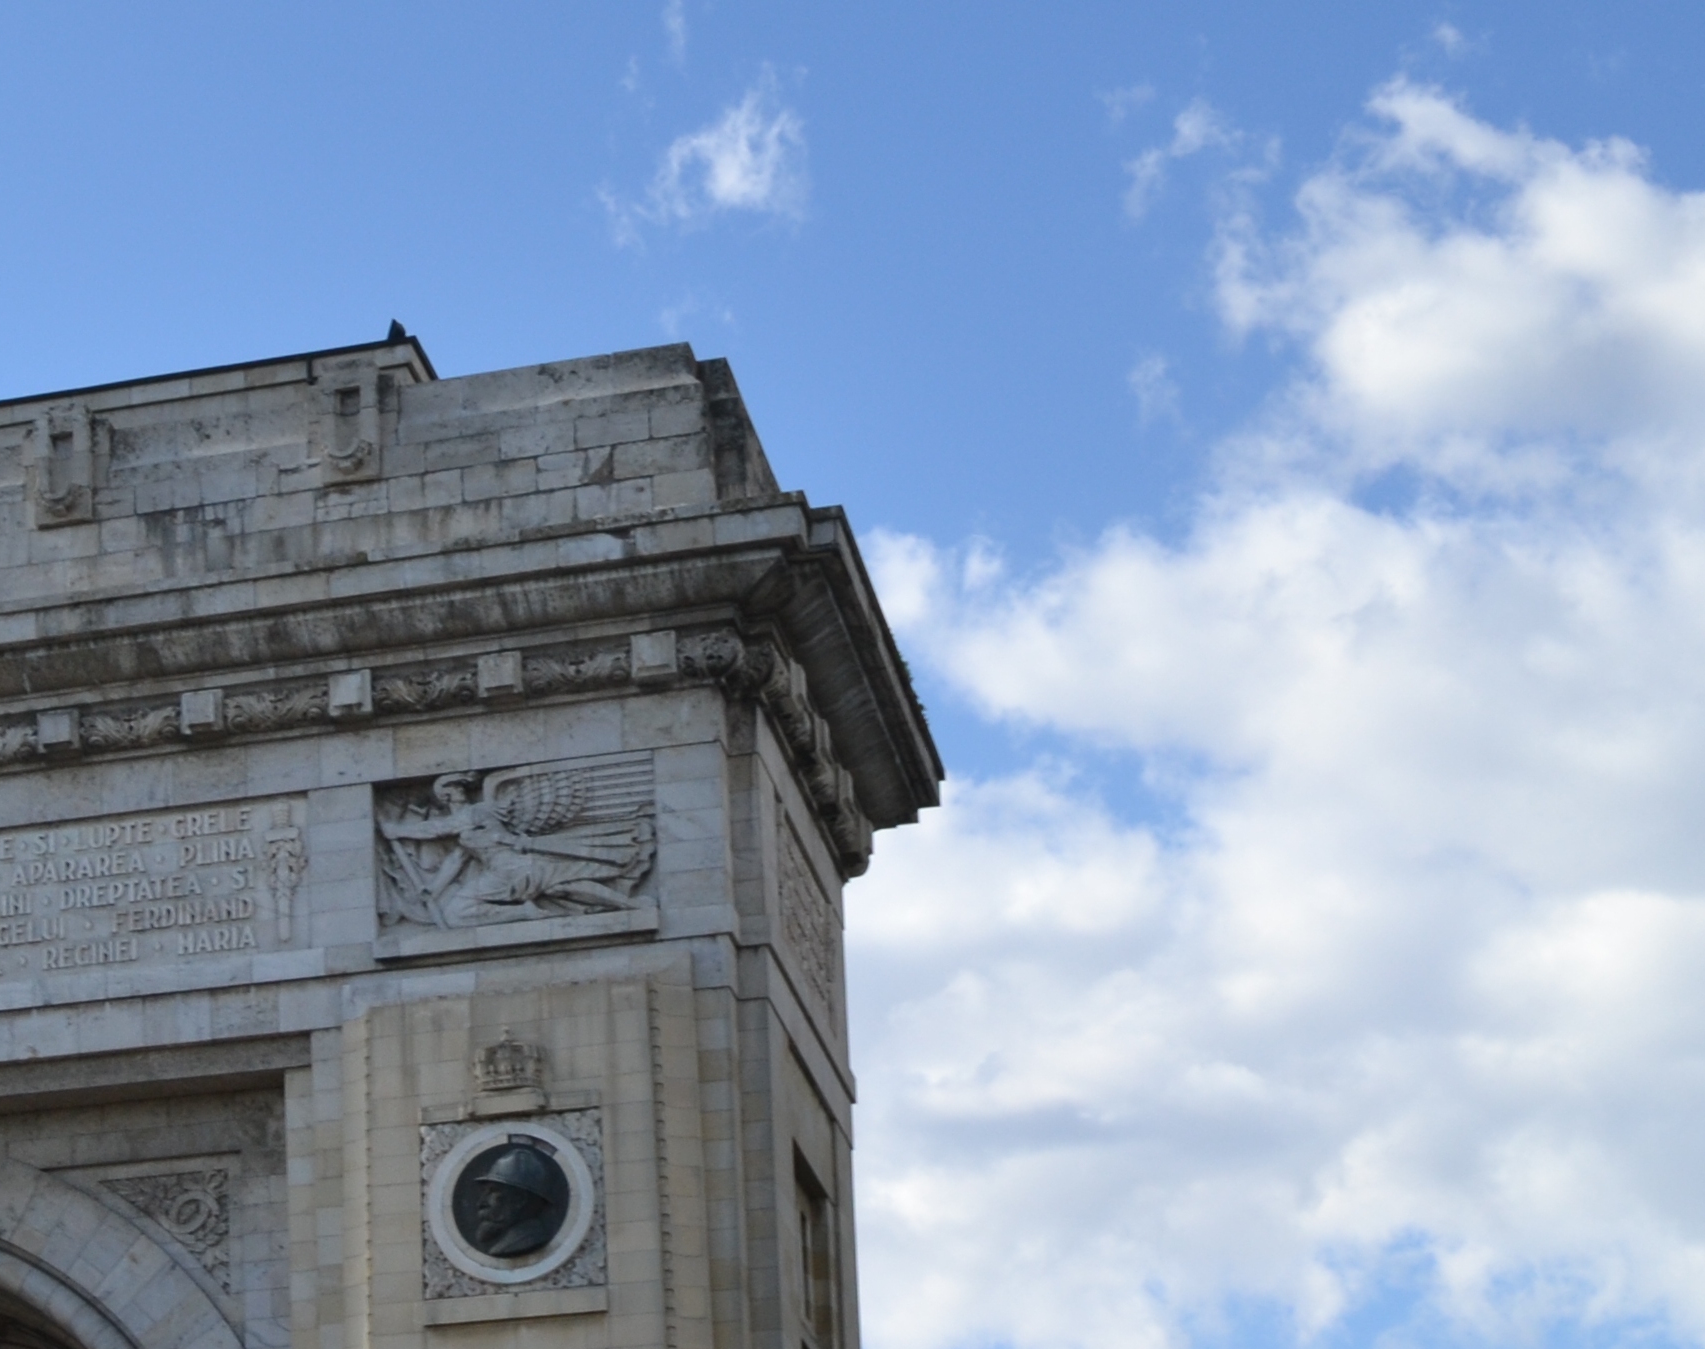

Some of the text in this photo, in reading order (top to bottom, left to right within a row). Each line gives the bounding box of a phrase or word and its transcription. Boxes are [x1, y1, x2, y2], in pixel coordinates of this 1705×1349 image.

[73, 820, 153, 851] LUPTE
[172, 808, 251, 840] GRELE
[10, 850, 145, 887] APARAREA
[179, 837, 255, 868] PLINA
[59, 874, 202, 911] DREPTATEA
[110, 897, 255, 934] FERDINAND
[43, 938, 140, 971] REGINEI
[176, 924, 256, 956] MARIA
